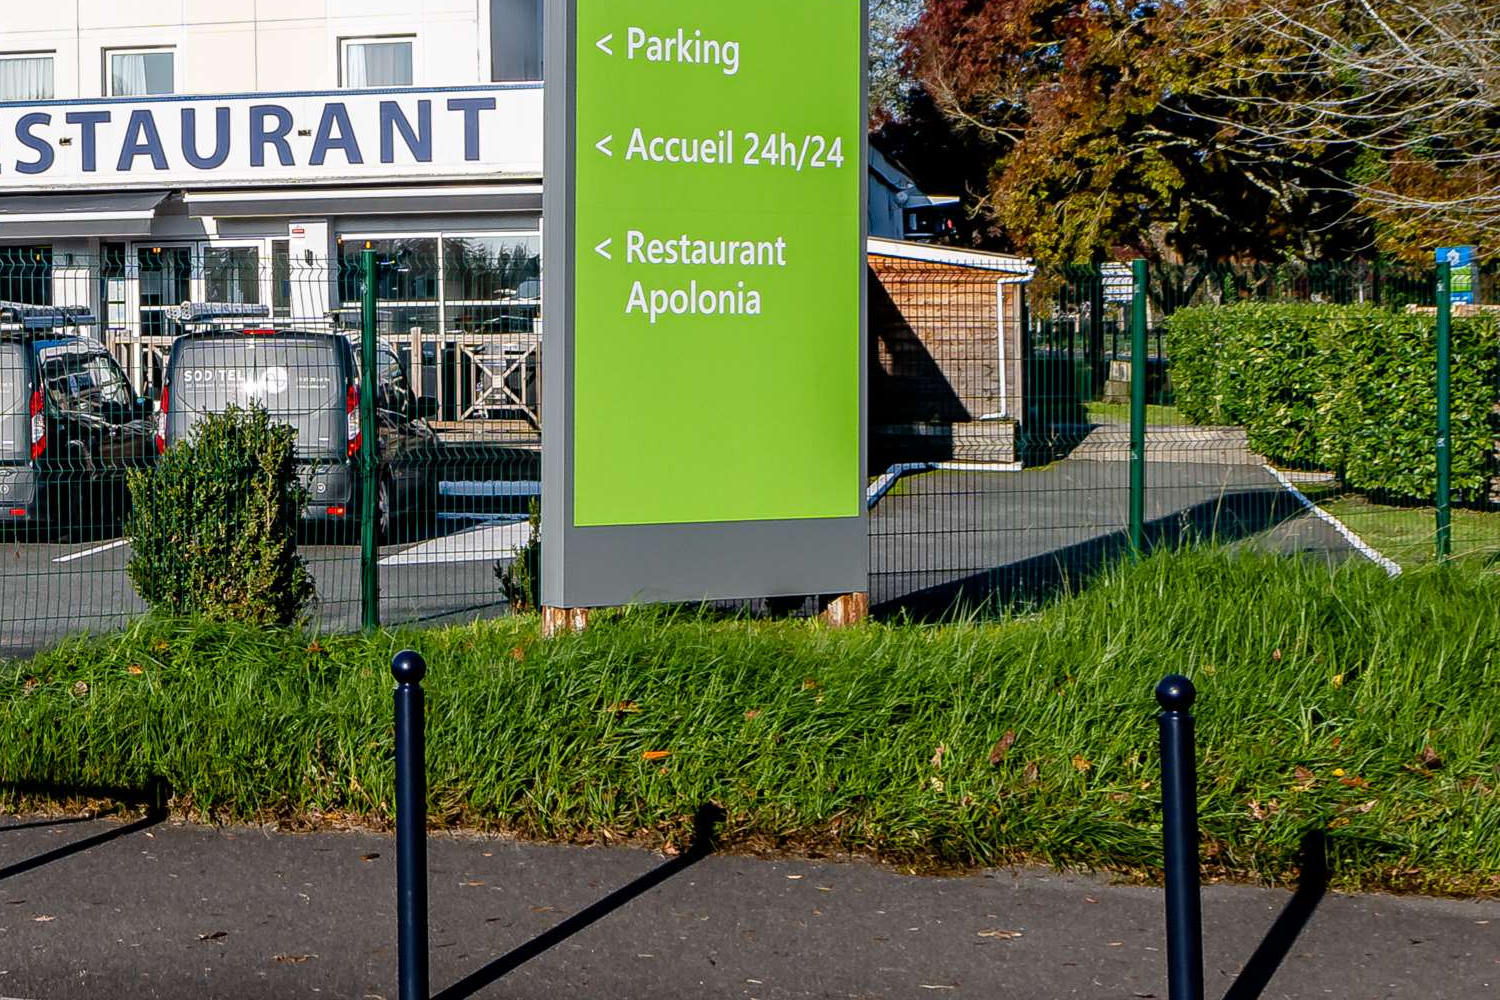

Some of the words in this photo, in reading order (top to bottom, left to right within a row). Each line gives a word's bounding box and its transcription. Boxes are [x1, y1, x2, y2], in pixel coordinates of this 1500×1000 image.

[627, 27, 740, 75] Parking
[625, 128, 734, 164] Accueil
[743, 132, 844, 171] 24h/24
[627, 230, 786, 266] Restaurant
[625, 280, 761, 324] Apolonia
[183, 369, 246, 382] SODTEL
